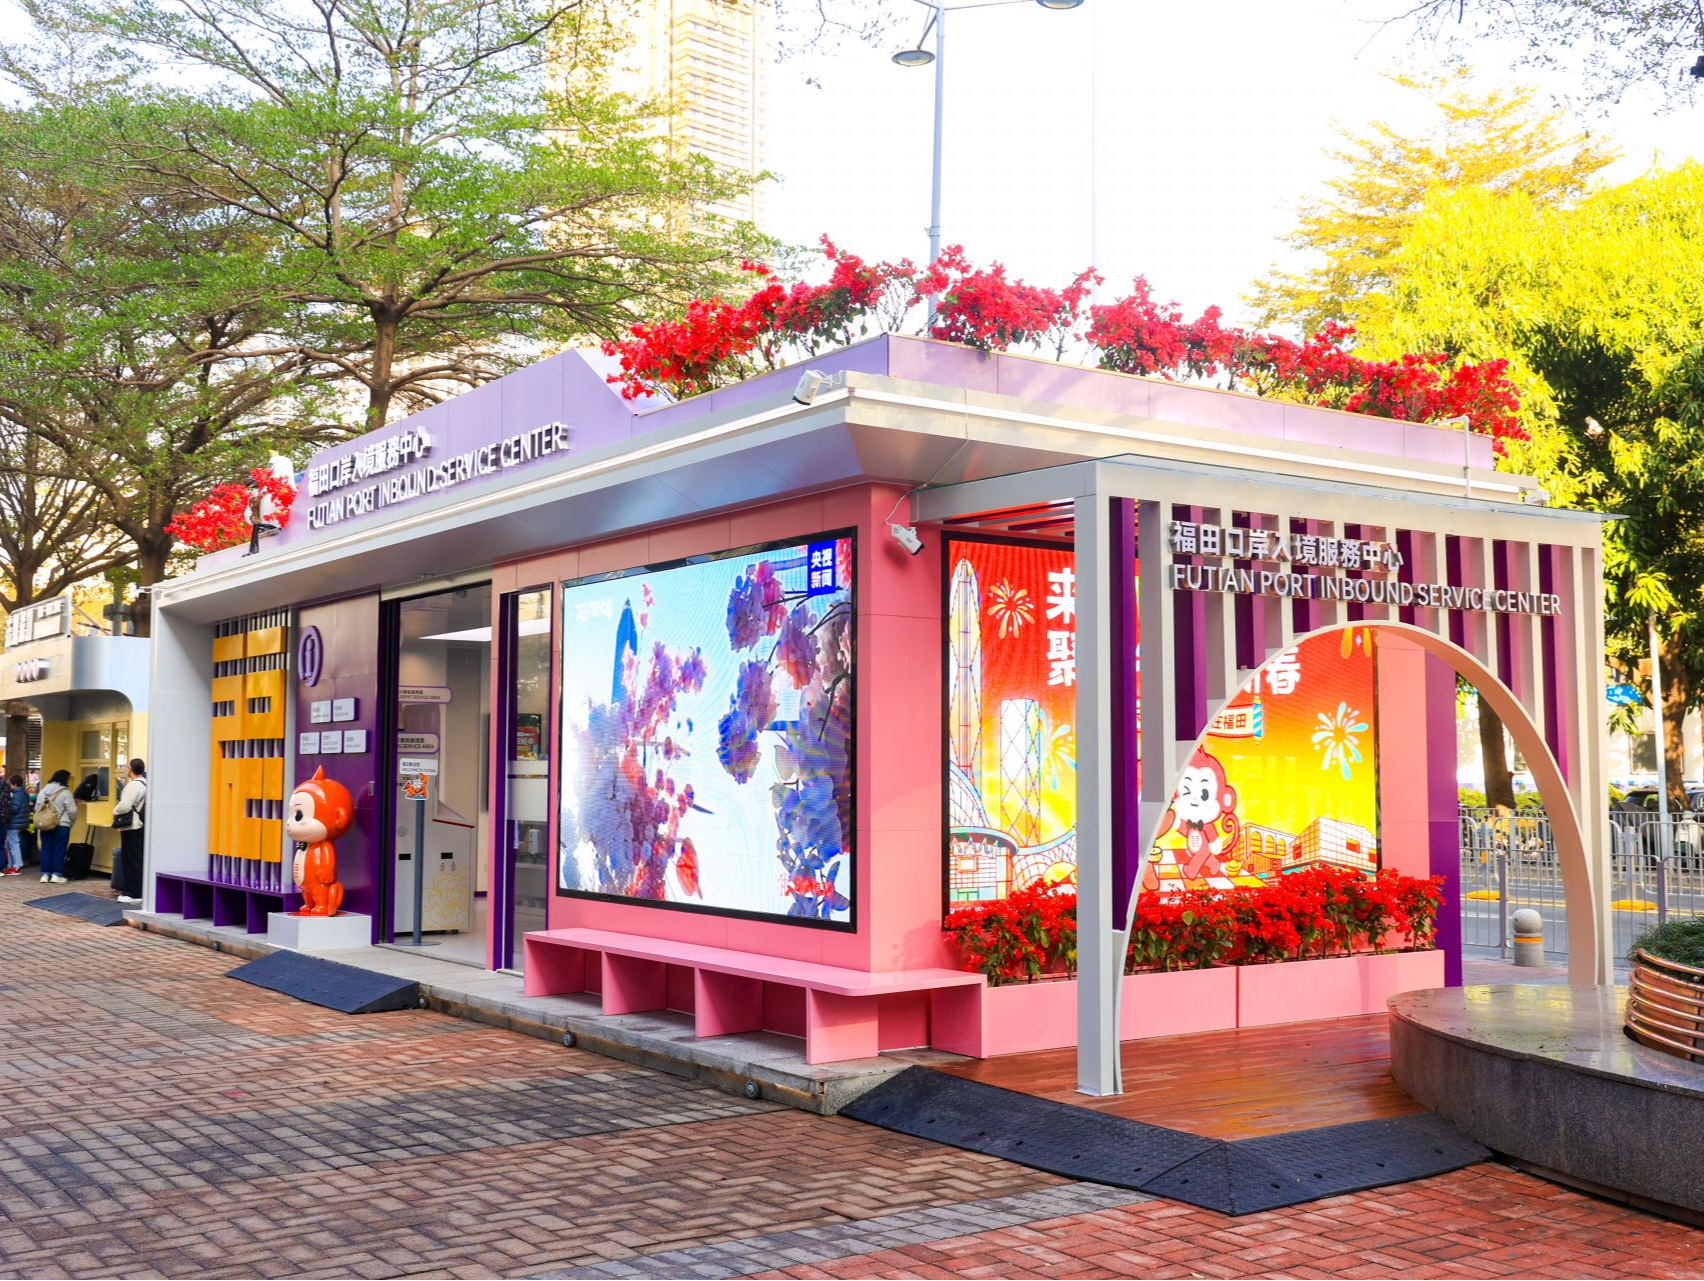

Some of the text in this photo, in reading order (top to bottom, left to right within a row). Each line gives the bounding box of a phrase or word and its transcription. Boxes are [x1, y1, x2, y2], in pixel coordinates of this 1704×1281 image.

[307, 421, 569, 530] FUTIAN PORT INBOUND SERVICE CENTER
[308, 425, 432, 497] 福田口岸入境服務中心
[811, 548, 833, 569] 央视
[1171, 520, 1404, 573] 福田口岸入境服務中心
[811, 569, 833, 588] 新闻
[1172, 563, 1562, 616] FUTIAN PORT INBOUND SERVICE CENTER
